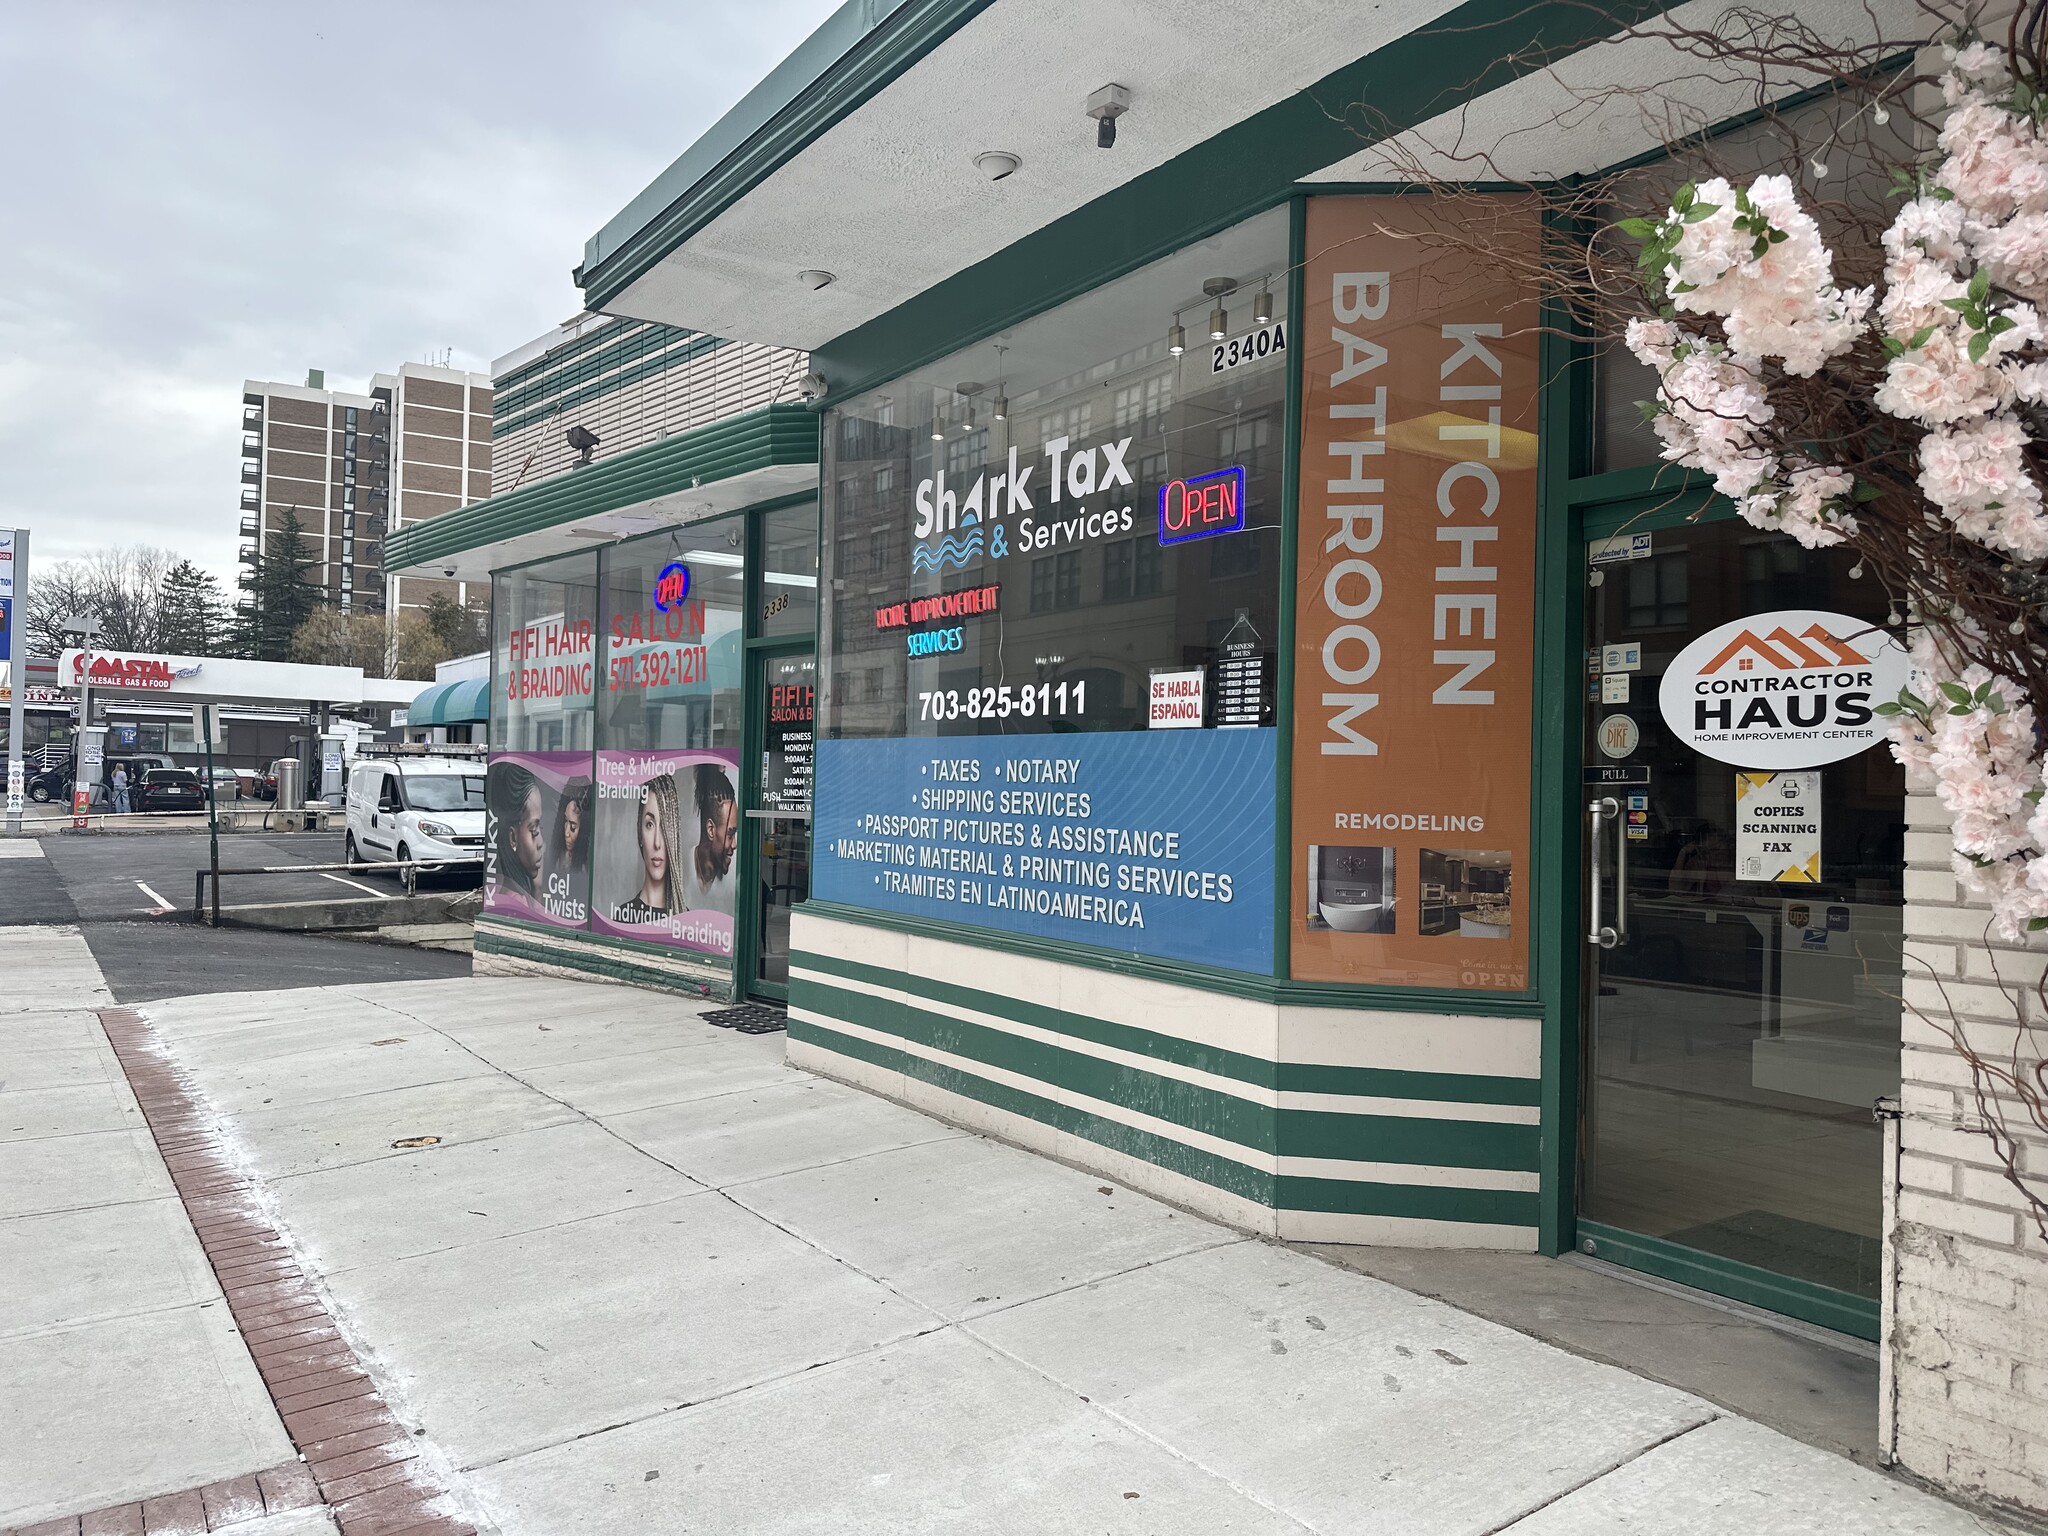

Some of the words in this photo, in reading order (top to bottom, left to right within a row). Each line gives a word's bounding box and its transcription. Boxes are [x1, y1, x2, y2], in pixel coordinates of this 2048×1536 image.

[1213, 324, 1286, 373] 2340A
[1045, 435, 1133, 503] Tax
[1321, 272, 1390, 755] BATHROOM
[1433, 323, 1503, 705] KITCHEN
[990, 524, 1009, 559] &
[1018, 505, 1133, 552] Services
[1633, 537, 1650, 547] ADT
[657, 573, 685, 604] OPEN
[763, 593, 789, 621] 2338
[875, 602, 909, 628] HOME
[910, 586, 999, 622] IMPROVEMENT
[611, 600, 706, 648] SALON
[510, 628, 539, 661] FIFI
[545, 620, 592, 657] HAIR
[907, 627, 963, 656] SERVICES
[1226, 642, 1255, 652] BUSINESS
[1231, 650, 1251, 658] HOURS
[609, 646, 707, 691] 571-392-1211
[76, 675, 121, 686] WOLESALE
[125, 678, 140, 686] GAS
[142, 678, 148, 687] &
[149, 679, 169, 688] FOOD
[508, 677, 517, 700] &
[520, 662, 592, 699] BRAIDING
[1152, 682, 1165, 699] SE
[1167, 680, 1201, 698] HABLA
[1694, 672, 1873, 695] CONTRACTOR
[771, 685, 801, 707] FIFI
[919, 680, 1086, 720] 703-825-8111
[100, 707, 106, 716] 5
[771, 708, 798, 722] SALON
[799, 707, 805, 721] &
[1151, 699, 1200, 720] ESPAÑOL
[1694, 691, 1873, 730] HAUS
[782, 732, 812, 741] BUSINESS
[1606, 728, 1629, 748] PIKE
[1694, 733, 1729, 742] HOME
[1731, 731, 1819, 741] IMPROVEMENT
[1822, 729, 1874, 739] CENTER
[784, 744, 814, 752] MONDAY-
[600, 758, 626, 776] Tree
[629, 758, 637, 776] &
[640, 756, 676, 776] Micro
[784, 755, 805, 764] 9:00AM
[784, 778, 805, 786] 8:00AM
[931, 759, 980, 782] TAXES
[1006, 759, 1081, 784] NOTARY
[1602, 769, 1629, 780] PULL
[598, 781, 650, 804] Braiding
[763, 791, 781, 802] PUSH
[921, 788, 994, 813] SHIPPING
[1000, 791, 1091, 818] SERVICES
[777, 803, 795, 811] WALK
[795, 803, 805, 811] INS
[1753, 806, 1805, 817] COPIES
[1335, 812, 1485, 833] REMODELING
[1742, 823, 1817, 834] SCANNING
[865, 814, 939, 840] PASSPORT
[944, 819, 1025, 848] PICTURES
[1030, 823, 1043, 849] &
[1047, 825, 1180, 859] ASSISTANCE
[1762, 842, 1792, 853] FAX
[485, 808, 500, 907] KINKY
[837, 839, 915, 866] MARKETING
[919, 846, 998, 876] MATERIAL
[1002, 853, 1014, 878] &
[1020, 855, 1110, 889] PRINTING
[1117, 864, 1234, 903] SERVICES
[548, 873, 570, 896] Gel
[542, 893, 586, 920] Twists
[883, 870, 956, 902] TRAMITES
[960, 880, 982, 906] EN
[987, 883, 1145, 929] LATINOAMERICA
[610, 902, 673, 929] Individual
[671, 919, 733, 953] Braiding
[1790, 911, 1809, 926] ups
[1461, 958, 1486, 969] Come
[1461, 971, 1525, 988] OPEN
